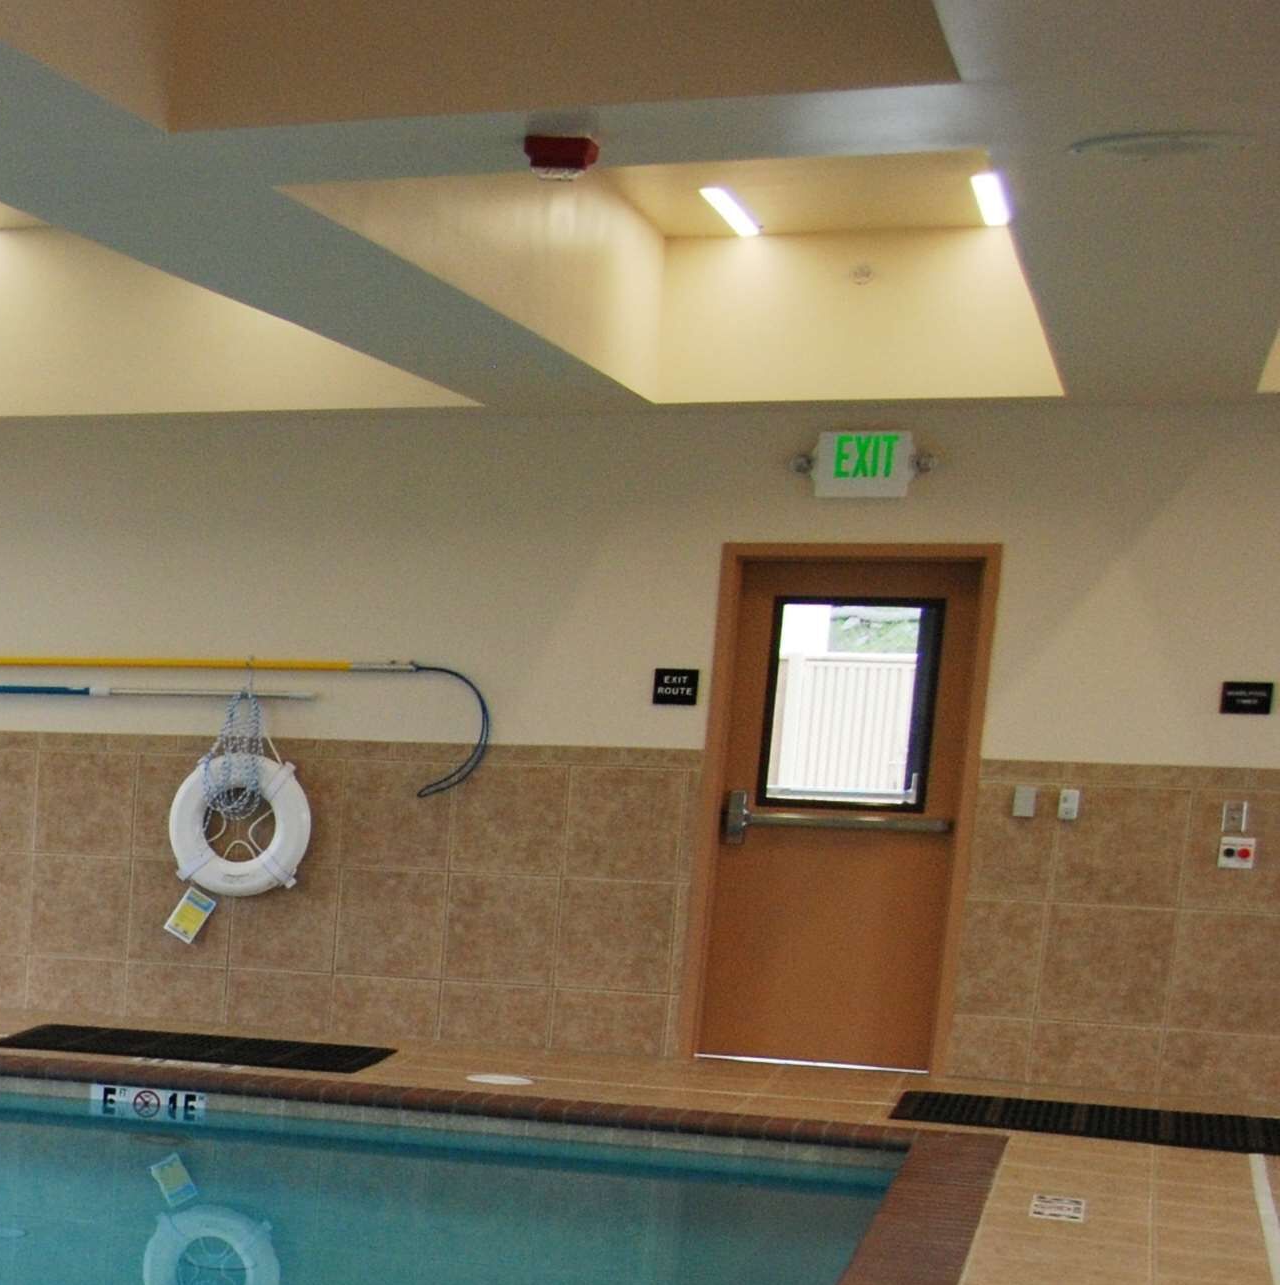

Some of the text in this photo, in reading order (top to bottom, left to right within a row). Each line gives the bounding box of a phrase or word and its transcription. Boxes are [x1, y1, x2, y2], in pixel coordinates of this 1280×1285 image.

[833, 434, 899, 478] EXIT
[664, 675, 689, 684] EXIT
[657, 686, 693, 696] ROUTE
